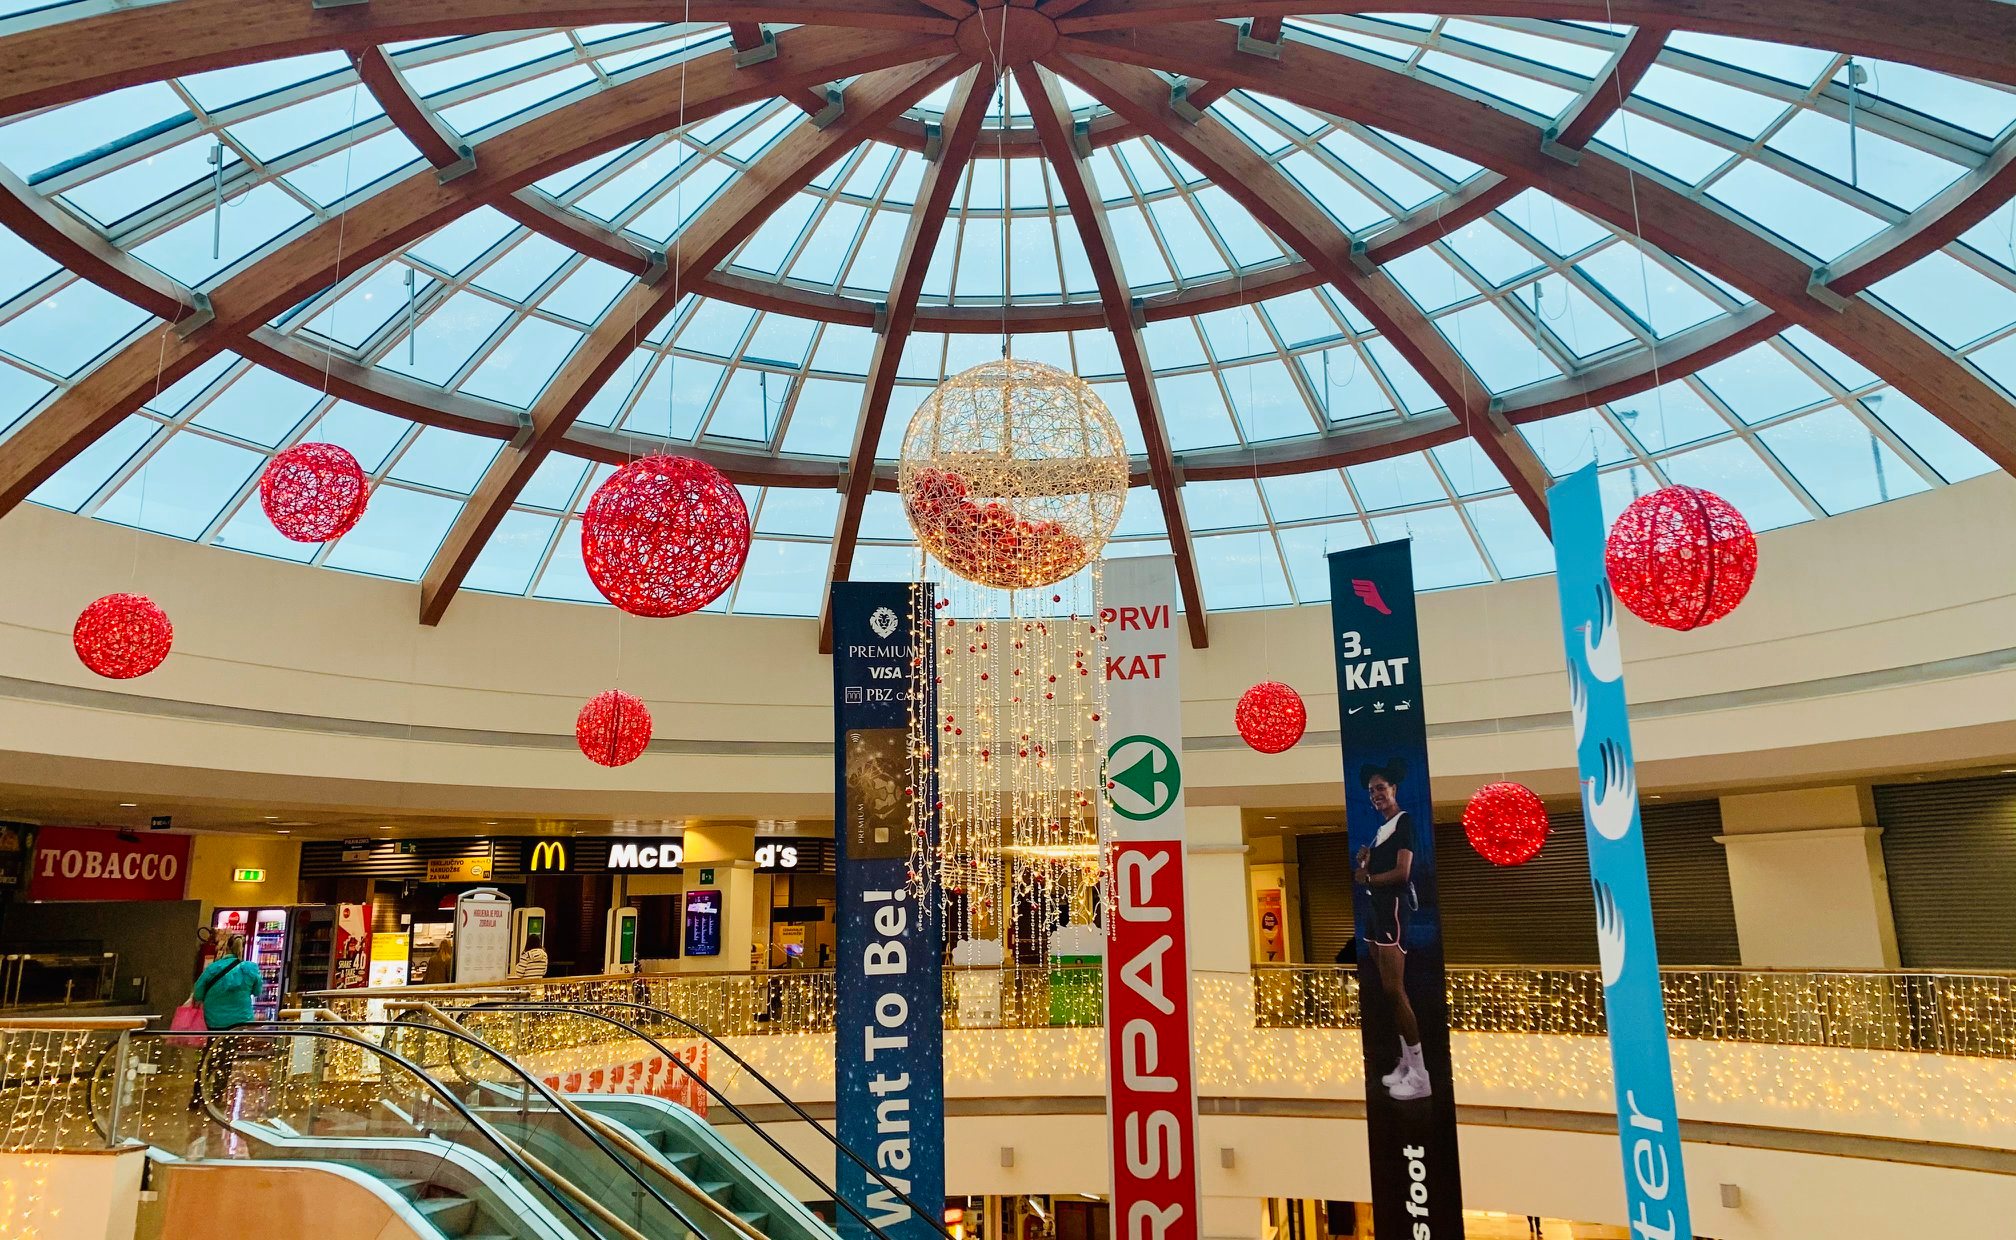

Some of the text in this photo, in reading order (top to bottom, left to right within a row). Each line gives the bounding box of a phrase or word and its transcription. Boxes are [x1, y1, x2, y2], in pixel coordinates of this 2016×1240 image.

[1101, 604, 1170, 632] PRVI
[849, 645, 919, 658] PREMIUM
[1343, 631, 1371, 658] 3.
[867, 666, 902, 679] VISA
[1106, 653, 1167, 681] KAT
[1345, 657, 1409, 690] KAT
[866, 688, 924, 701] PBZ CAR
[40, 849, 178, 881] TOBACCO
[608, 844, 798, 868] McDd's
[863, 889, 912, 1232] Want To Be!
[1626, 1089, 1677, 1240] ter
[1403, 1144, 1429, 1218] foot
